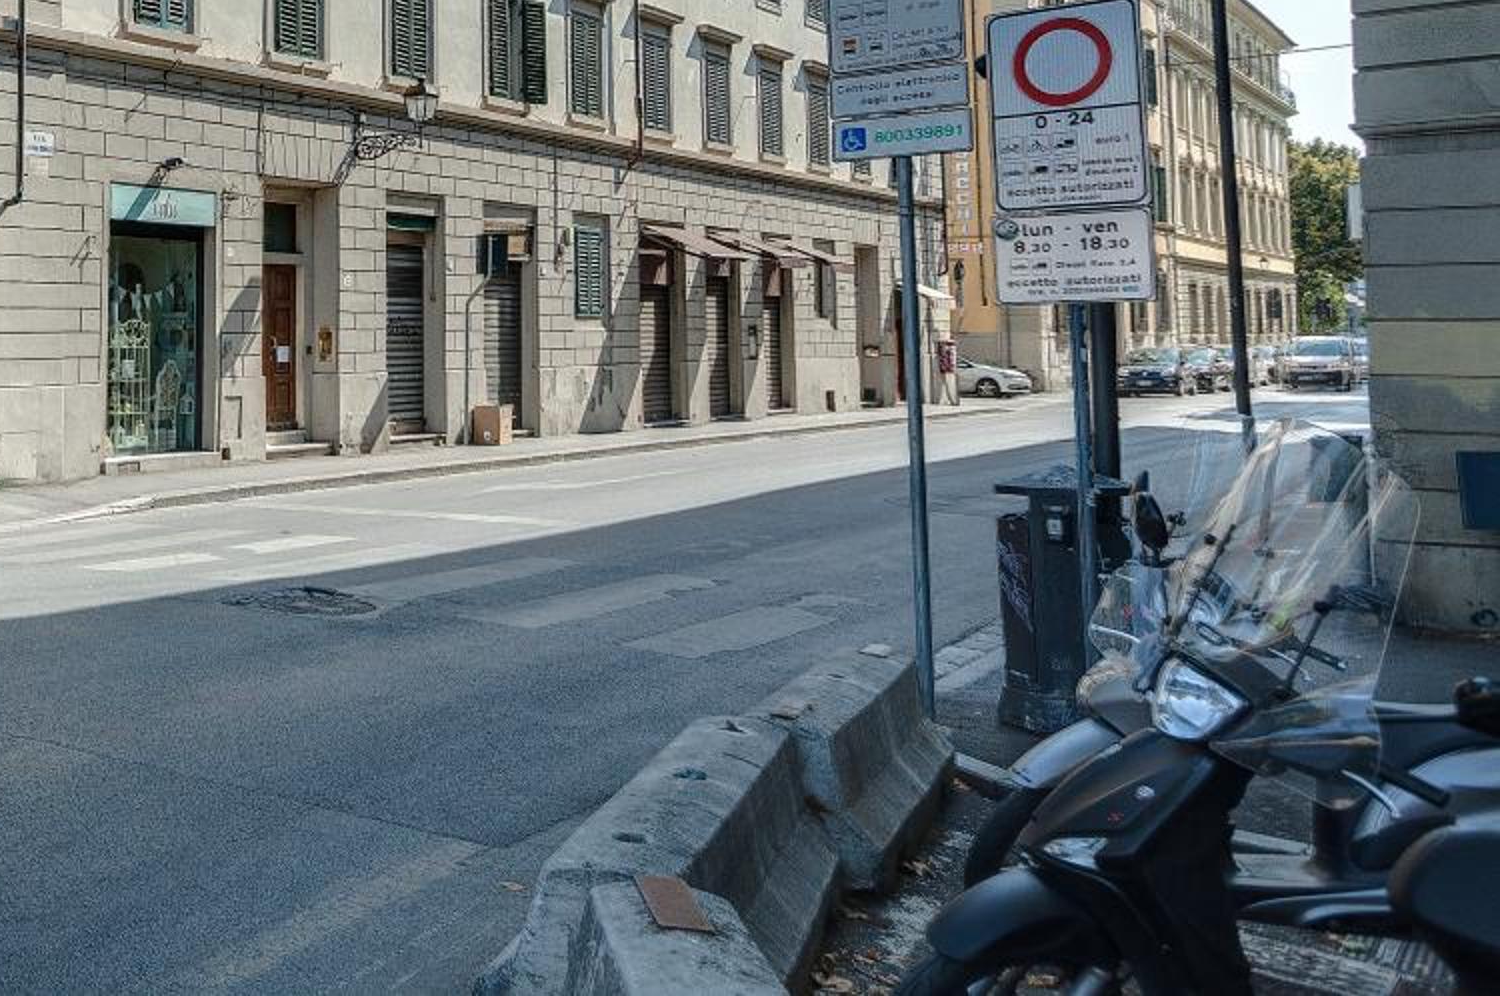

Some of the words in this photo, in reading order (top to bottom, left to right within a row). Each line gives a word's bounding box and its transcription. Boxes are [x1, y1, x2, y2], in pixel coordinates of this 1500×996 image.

[837, 82, 891, 95] Controllo
[895, 72, 960, 87] elettronico
[1035, 115, 1048, 129] 0
[1067, 111, 1094, 126] 24
[874, 124, 964, 143] 800339891
[1008, 186, 1056, 197] eccetto
[1061, 179, 1135, 193] autorizzati
[1022, 223, 1054, 237] lun
[1081, 220, 1119, 233] ven
[1007, 277, 1059, 288] eccetto
[1065, 273, 1141, 286] autorizzati
